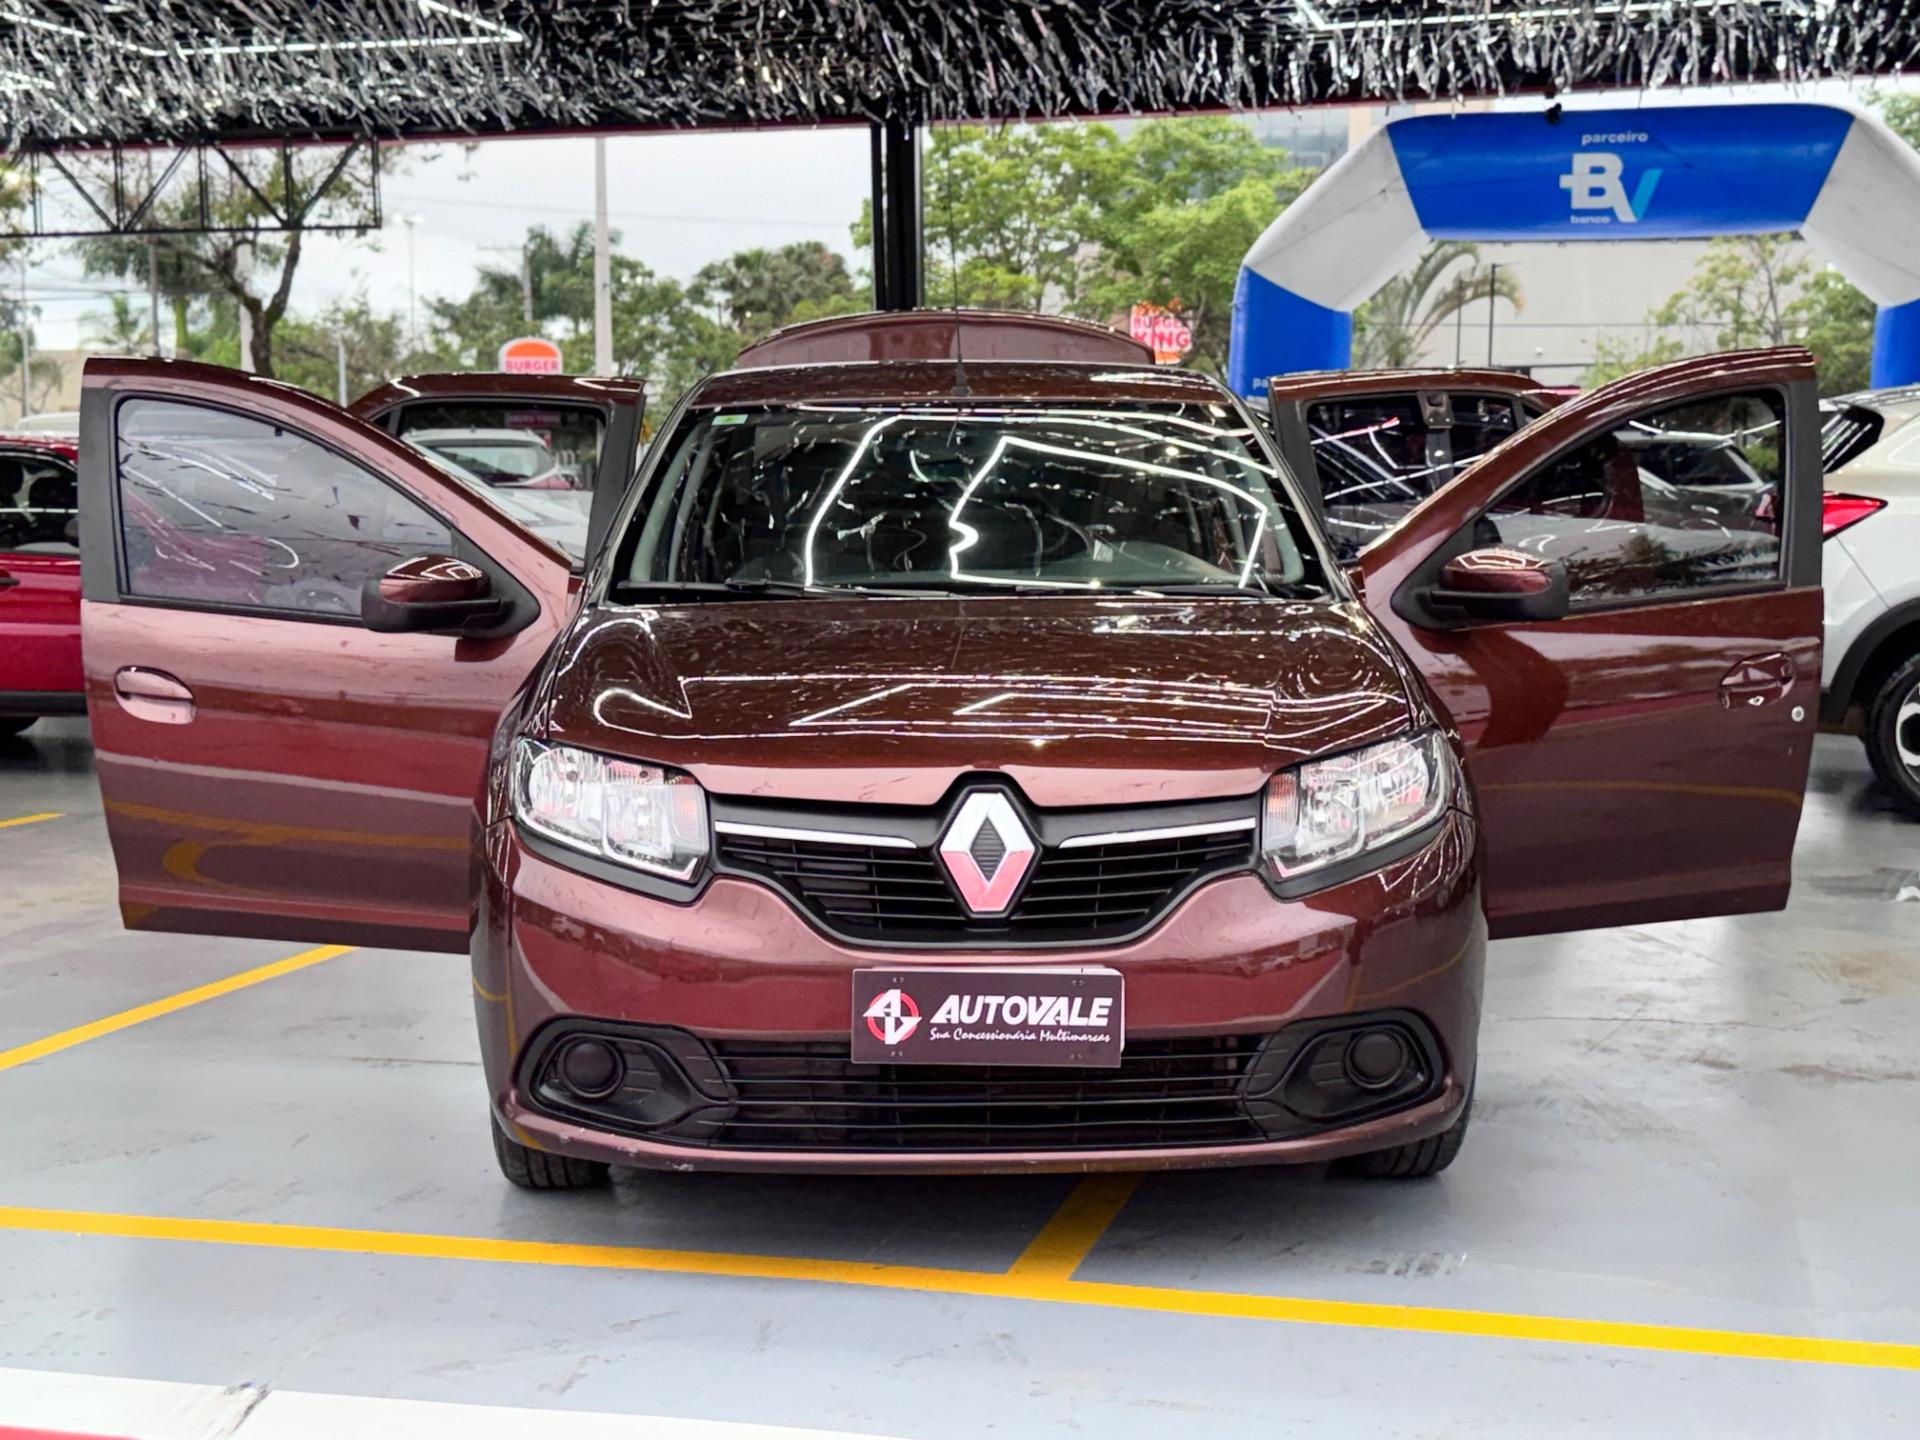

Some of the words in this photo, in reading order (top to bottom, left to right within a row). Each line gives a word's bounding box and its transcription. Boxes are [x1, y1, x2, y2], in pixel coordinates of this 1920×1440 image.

[1581, 129, 1649, 147] parceiro
[1133, 330, 1190, 348] KING
[505, 360, 558, 371] BURGER
[930, 994, 1113, 1027] AUTOVALE
[929, 1026, 950, 1041] Sua
[1039, 1028, 1112, 1044] Multimarcas
